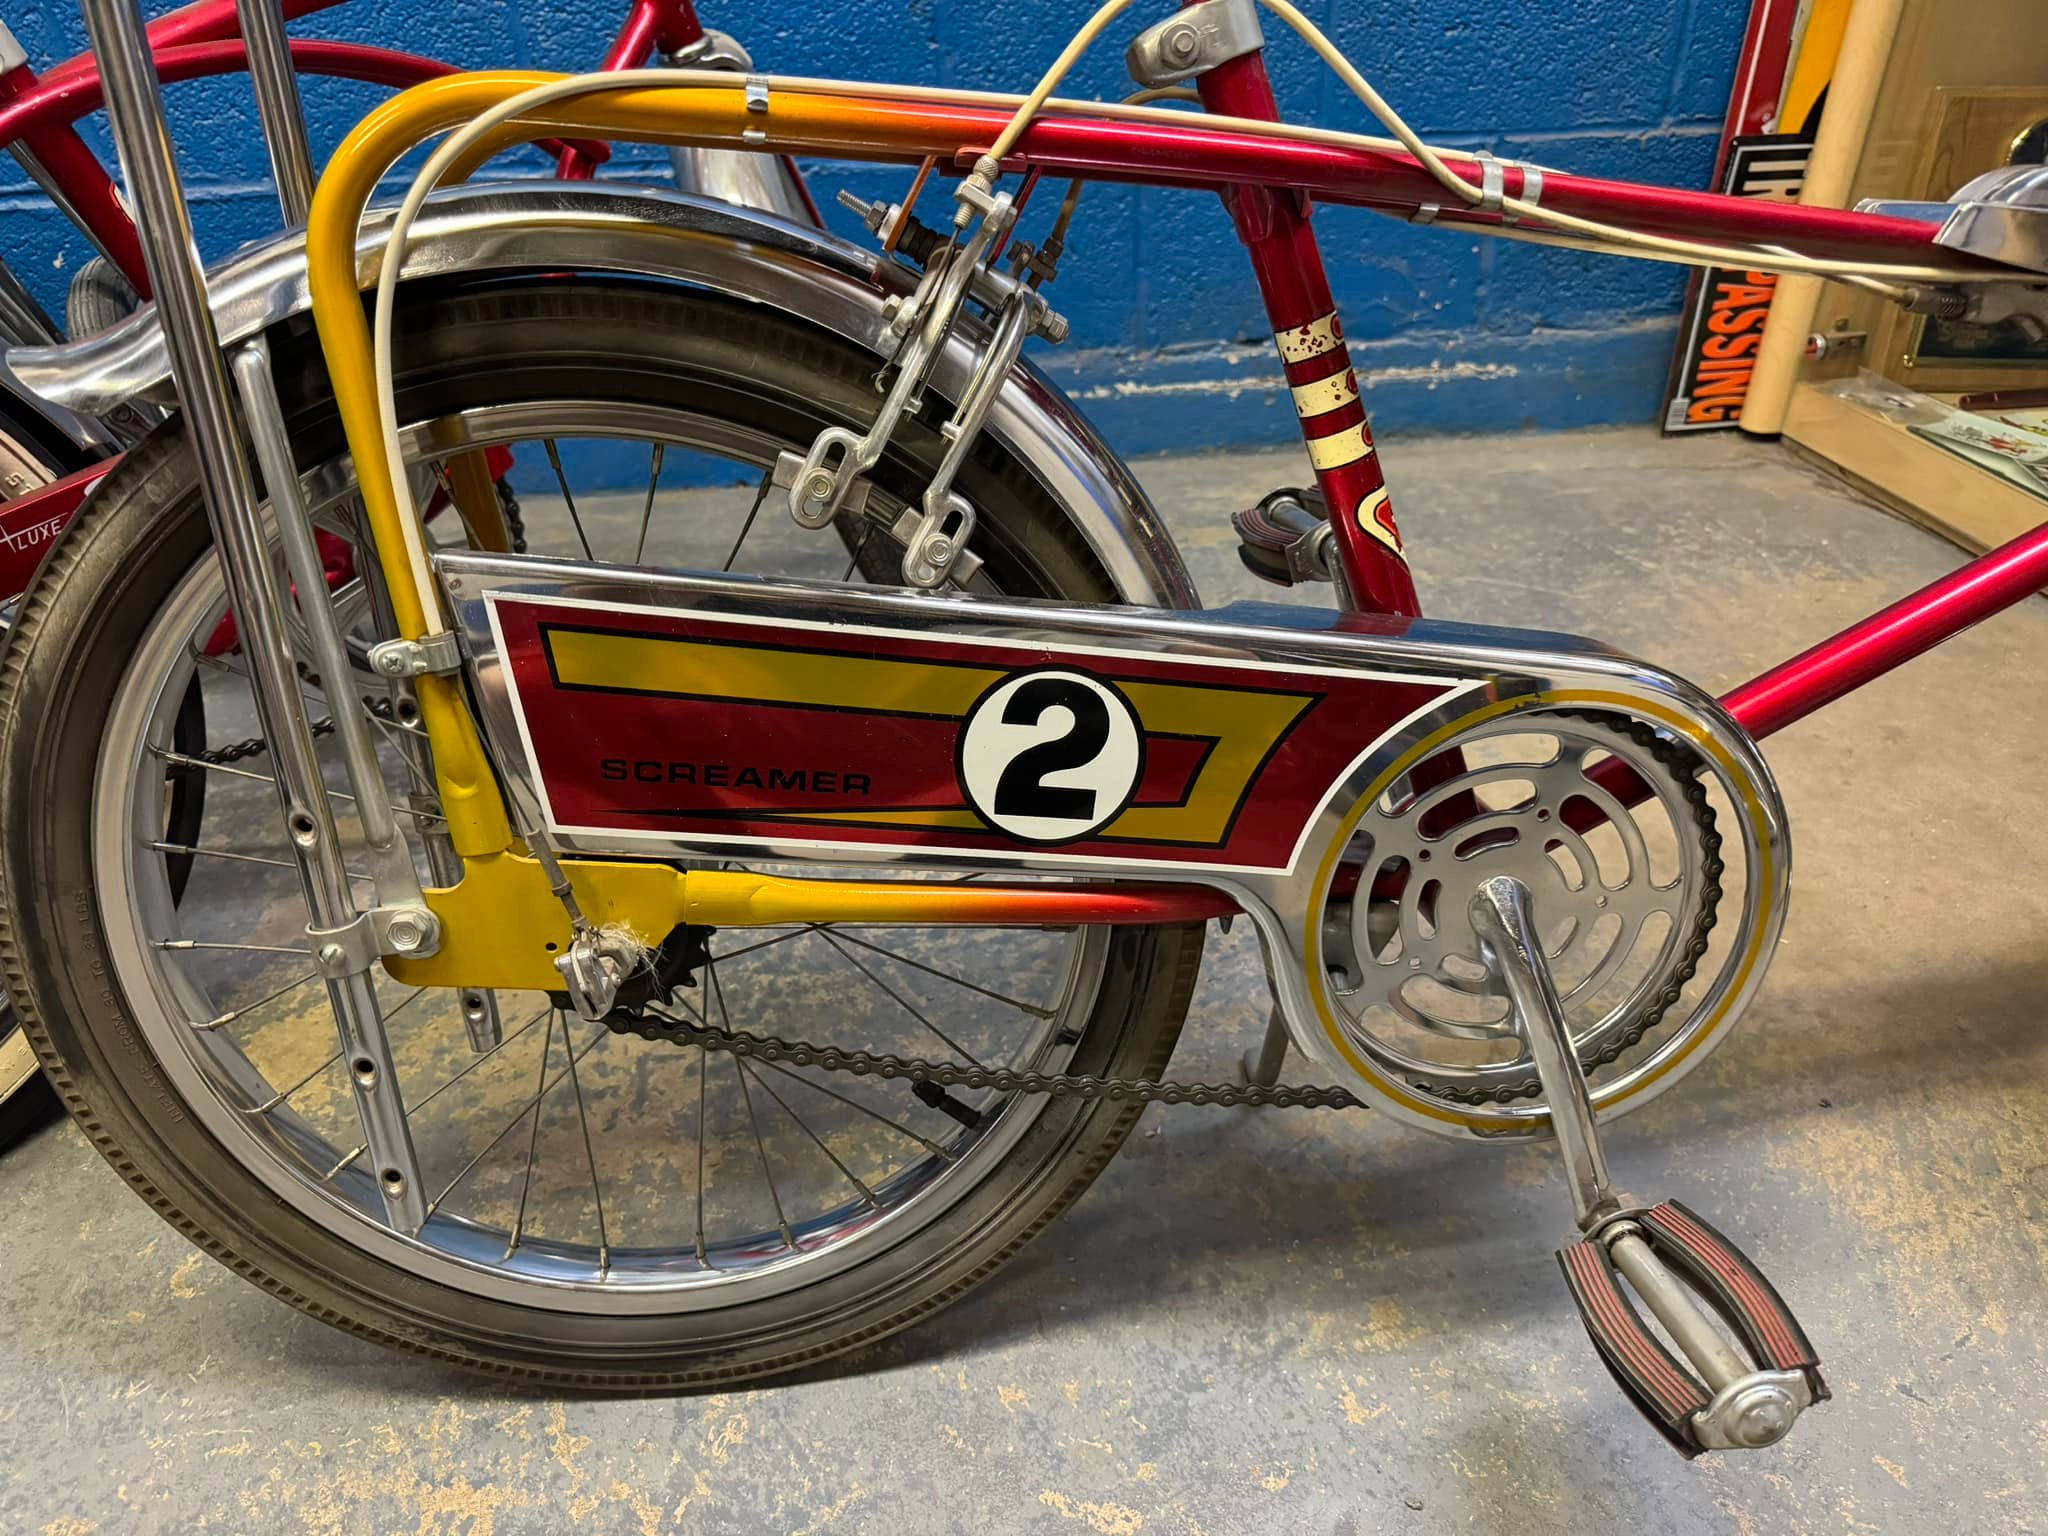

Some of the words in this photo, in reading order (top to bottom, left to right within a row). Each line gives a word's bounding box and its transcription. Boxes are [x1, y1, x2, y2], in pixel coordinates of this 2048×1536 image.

[16, 519, 62, 550] LUXE
[994, 677, 1111, 821] 2
[601, 758, 871, 795] SCREAMER
